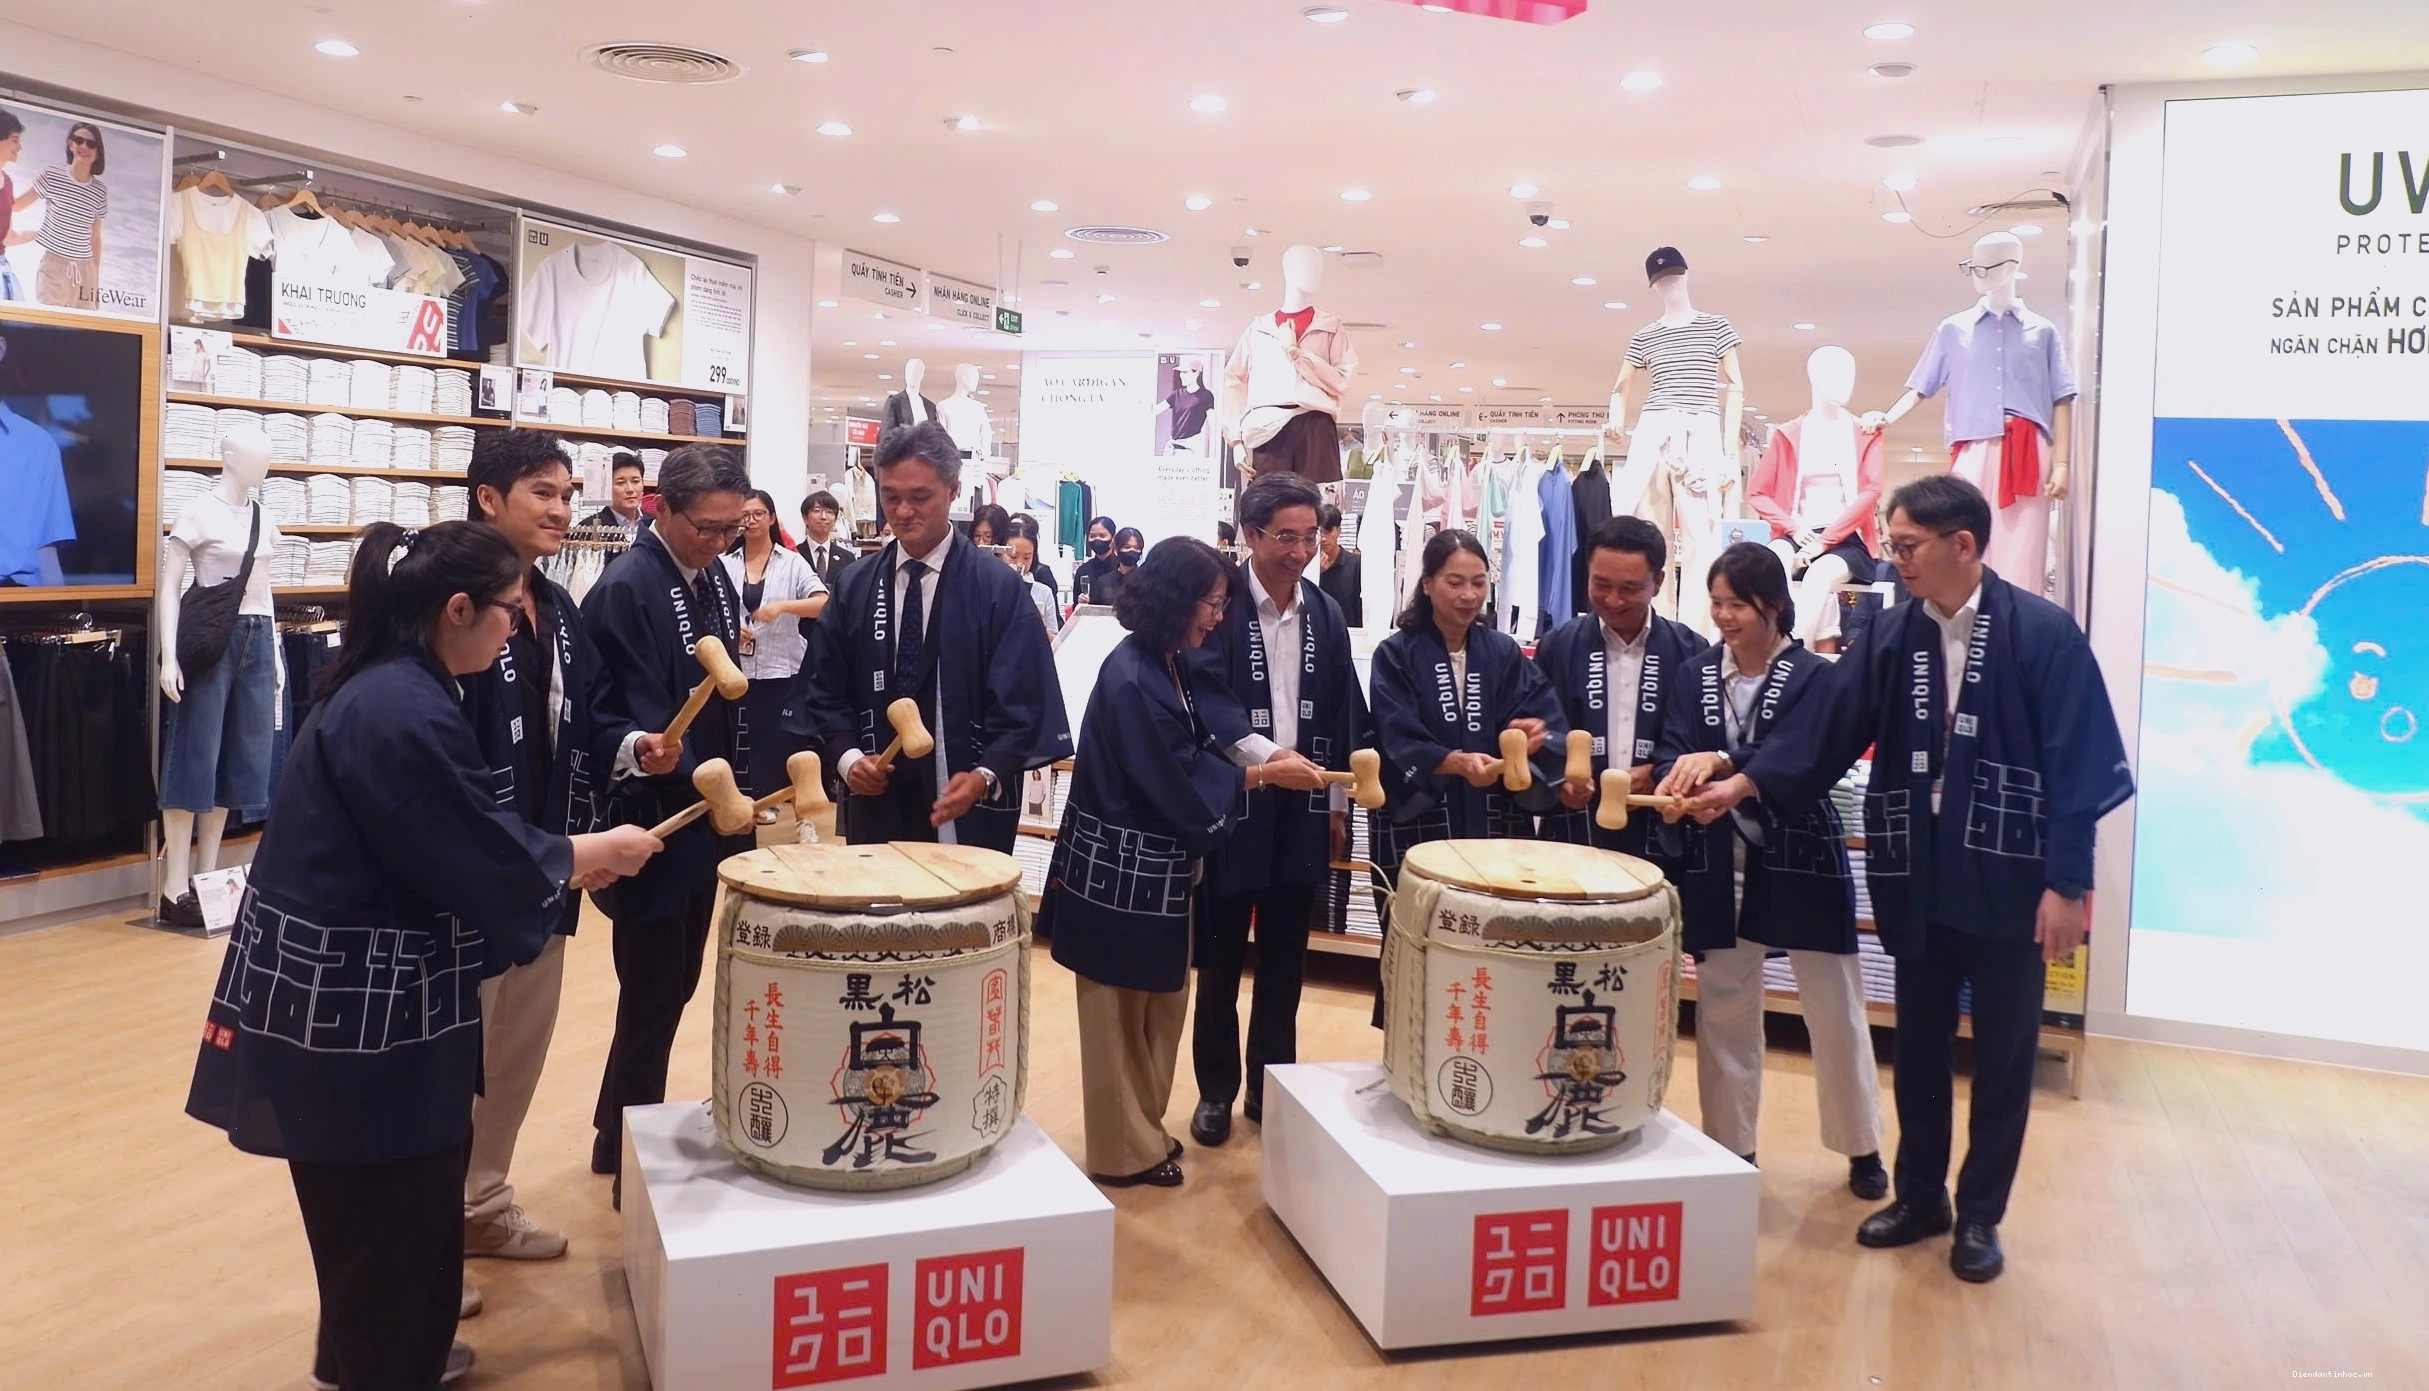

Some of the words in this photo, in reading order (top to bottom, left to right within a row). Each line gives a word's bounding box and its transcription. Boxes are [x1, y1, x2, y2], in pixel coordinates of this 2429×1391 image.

[2339, 151, 2429, 216] UV
[79, 286, 147, 308] LifeWear
[281, 282, 312, 301] KHAI
[2271, 290, 2319, 318] SẢN
[2331, 286, 2400, 317] PHẨM
[2270, 334, 2319, 354] NGĂN
[2327, 334, 2378, 358] CHẶN
[2387, 325, 2429, 354] HƠ
[669, 586, 696, 656] UNIQLO
[713, 575, 735, 640] UNIQLO
[1248, 620, 1265, 681] UNIQLO
[1965, 613, 1991, 684] UNIQLO
[1434, 662, 1457, 723] UNIQLO
[1466, 672, 1481, 732] UNIQLO
[1588, 651, 1604, 710] UNIQLO
[1641, 654, 1660, 713] UNIQLO
[1700, 664, 1720, 727] UNIQLO
[1760, 659, 1795, 720] UNIQLO
[1911, 650, 1929, 720] UNIQLO
[735, 919, 772, 950] 登録
[1437, 909, 1481, 937] 登録
[763, 981, 785, 1080] 長生自得
[1468, 966, 1493, 1055] 長生自得
[1486, 1222, 1555, 1261] ユニ
[1600, 1214, 1666, 1253] UNI
[790, 1279, 872, 1327] ユニ
[927, 1263, 1004, 1308] UNI
[1482, 1264, 1555, 1304] クロ
[1599, 1255, 1670, 1299] QLO
[785, 1325, 872, 1375] クロ
[925, 1308, 1009, 1360] QLO
